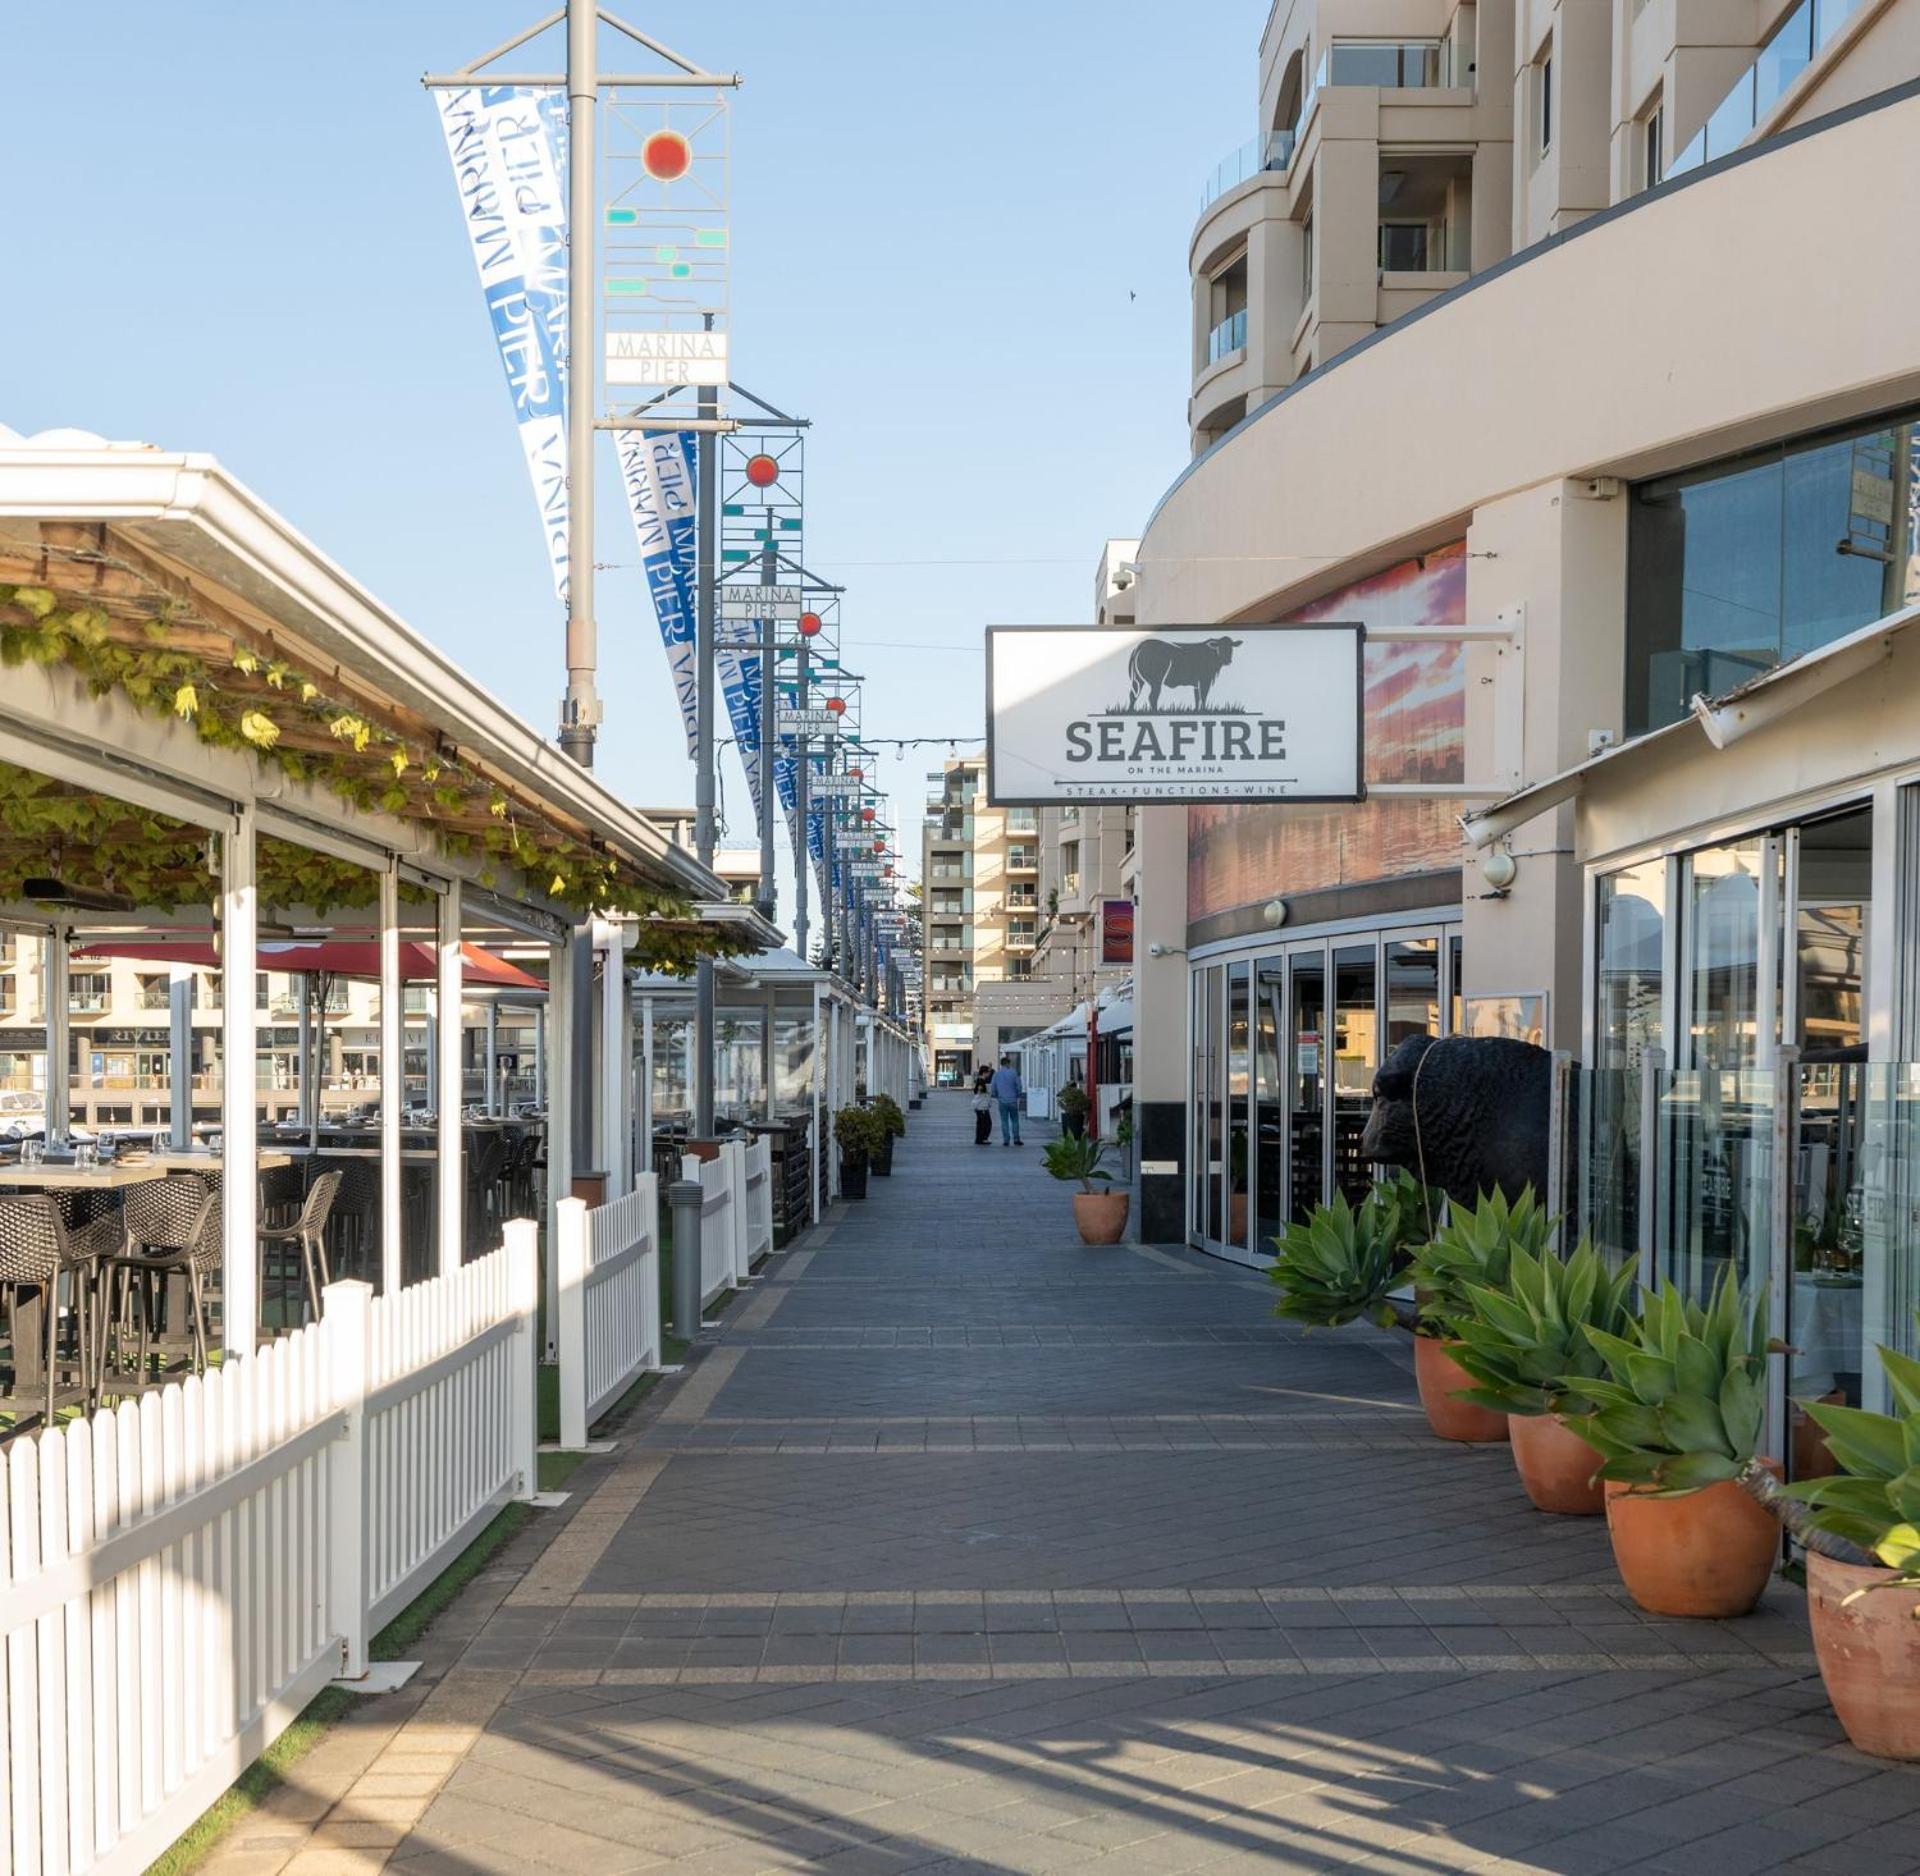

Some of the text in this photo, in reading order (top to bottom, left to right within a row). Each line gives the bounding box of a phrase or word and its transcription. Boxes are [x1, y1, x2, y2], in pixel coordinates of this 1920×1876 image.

[491, 291, 551, 414] PIER
[616, 335, 716, 358] MARINA
[641, 361, 689, 382] PIER
[653, 443, 688, 510] PIER
[648, 561, 686, 645] PIER
[729, 587, 794, 601] MARINA
[745, 603, 777, 618] PIER
[1066, 720, 1286, 762] SEAFIRE
[1128, 765, 1224, 775] ON THE MARINA
[1066, 784, 1288, 797] STEAK FUNCTIONS WINE
